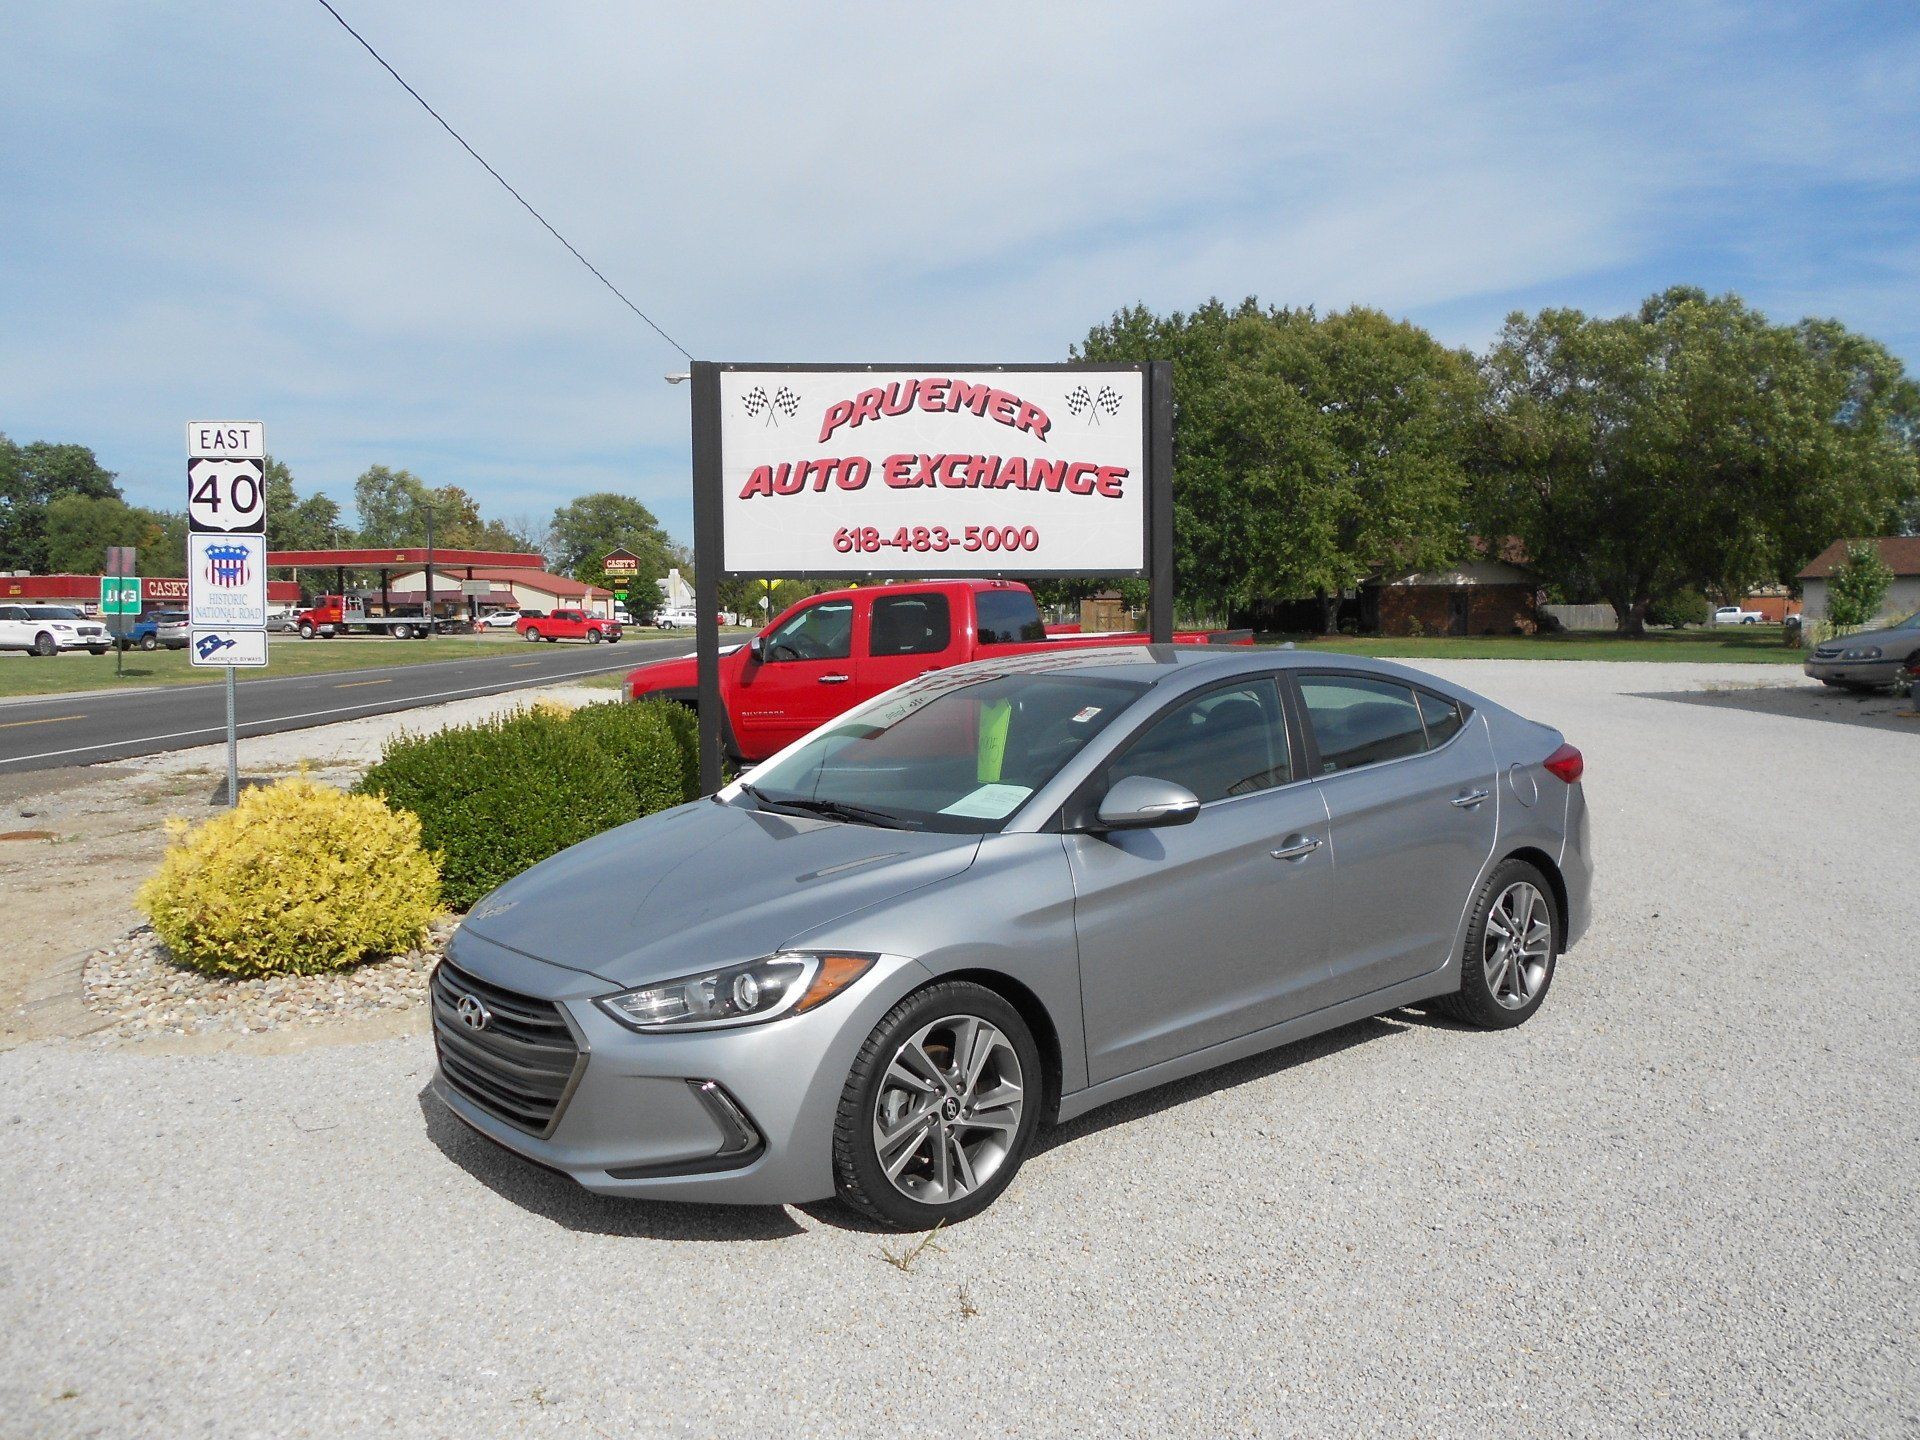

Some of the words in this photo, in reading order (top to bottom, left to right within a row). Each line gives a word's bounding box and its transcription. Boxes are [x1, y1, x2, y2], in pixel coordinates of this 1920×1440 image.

[819, 377, 1052, 443] PRUEMER
[200, 429, 250, 449] EAST
[739, 455, 872, 500] AUTO
[881, 453, 1131, 499] EXCHANGE
[192, 474, 258, 514] 40
[832, 525, 1039, 553] 618-483-5000
[195, 606, 237, 619] NATIONAL
[239, 607, 262, 620] ROAD
[209, 593, 248, 605] HISTORIC
